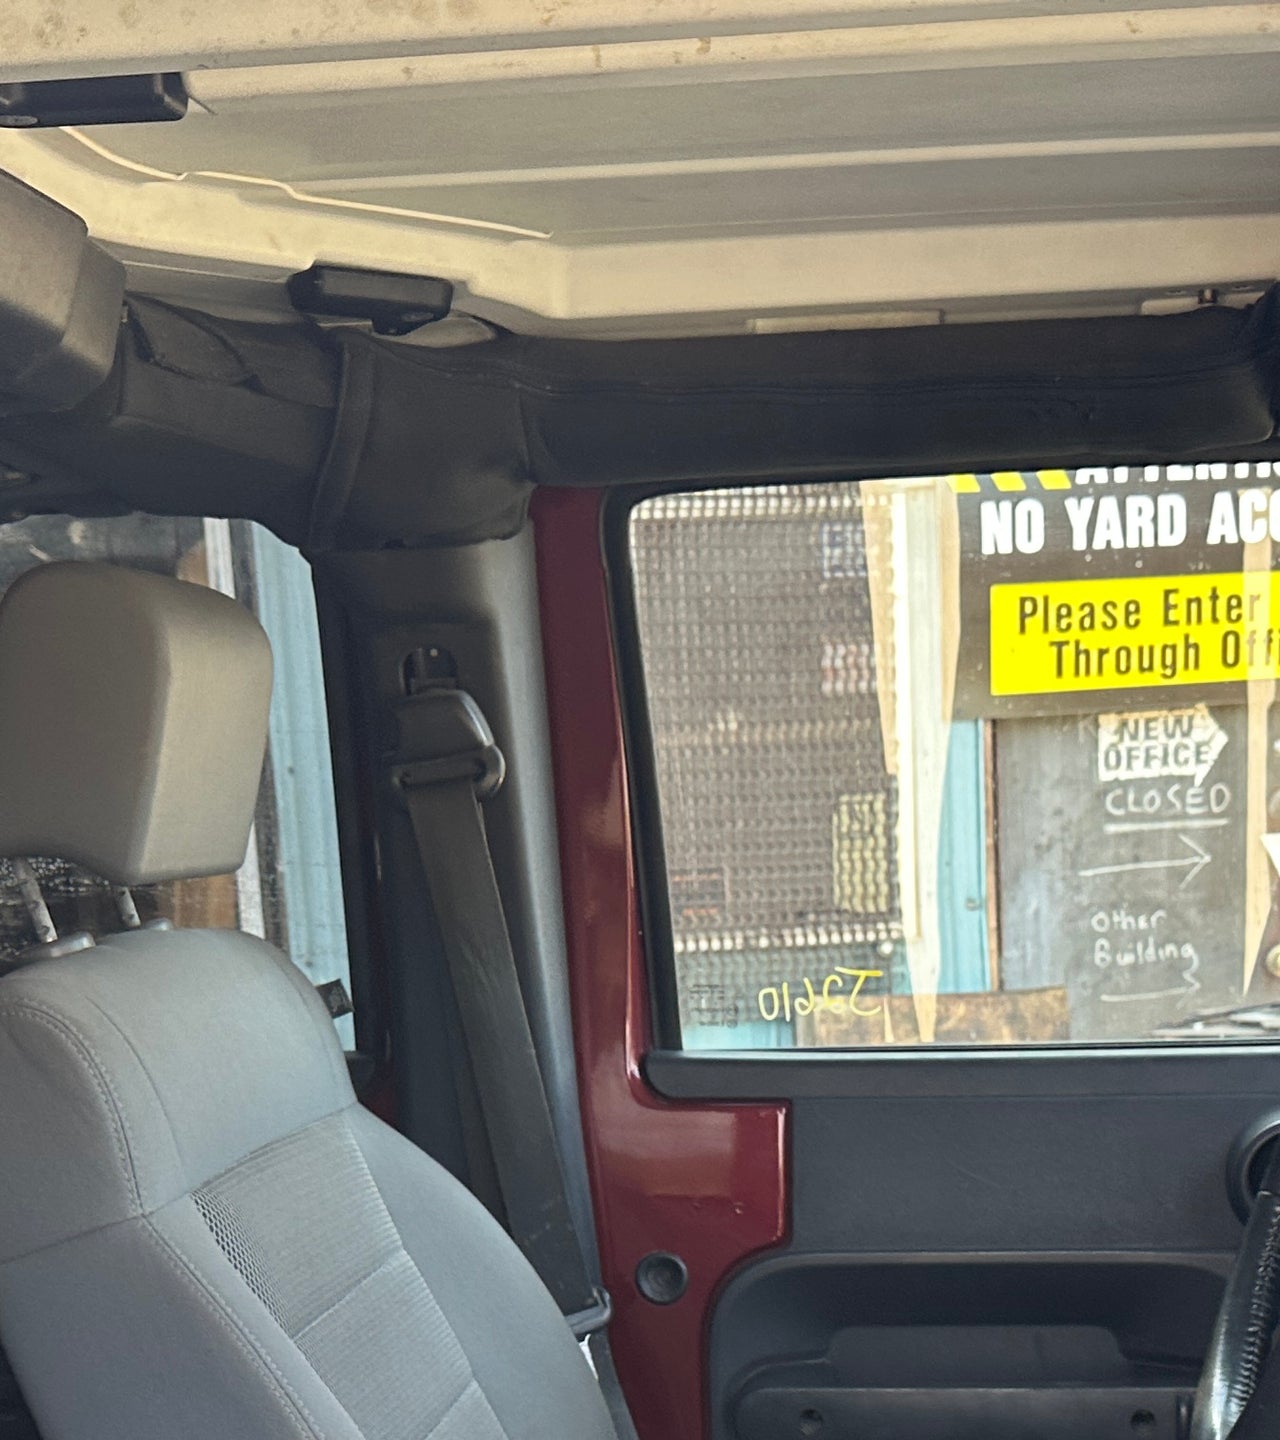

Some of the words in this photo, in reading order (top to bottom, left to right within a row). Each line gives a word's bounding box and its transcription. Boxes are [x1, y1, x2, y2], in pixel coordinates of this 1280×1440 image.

[980, 497, 1045, 555] NO
[1064, 493, 1187, 550] YARD
[1019, 596, 1141, 635] Please
[1162, 588, 1261, 627] Enter
[1050, 633, 1201, 679] Through
[1120, 717, 1195, 742] NEW
[1104, 783, 1231, 816] CLOSED
